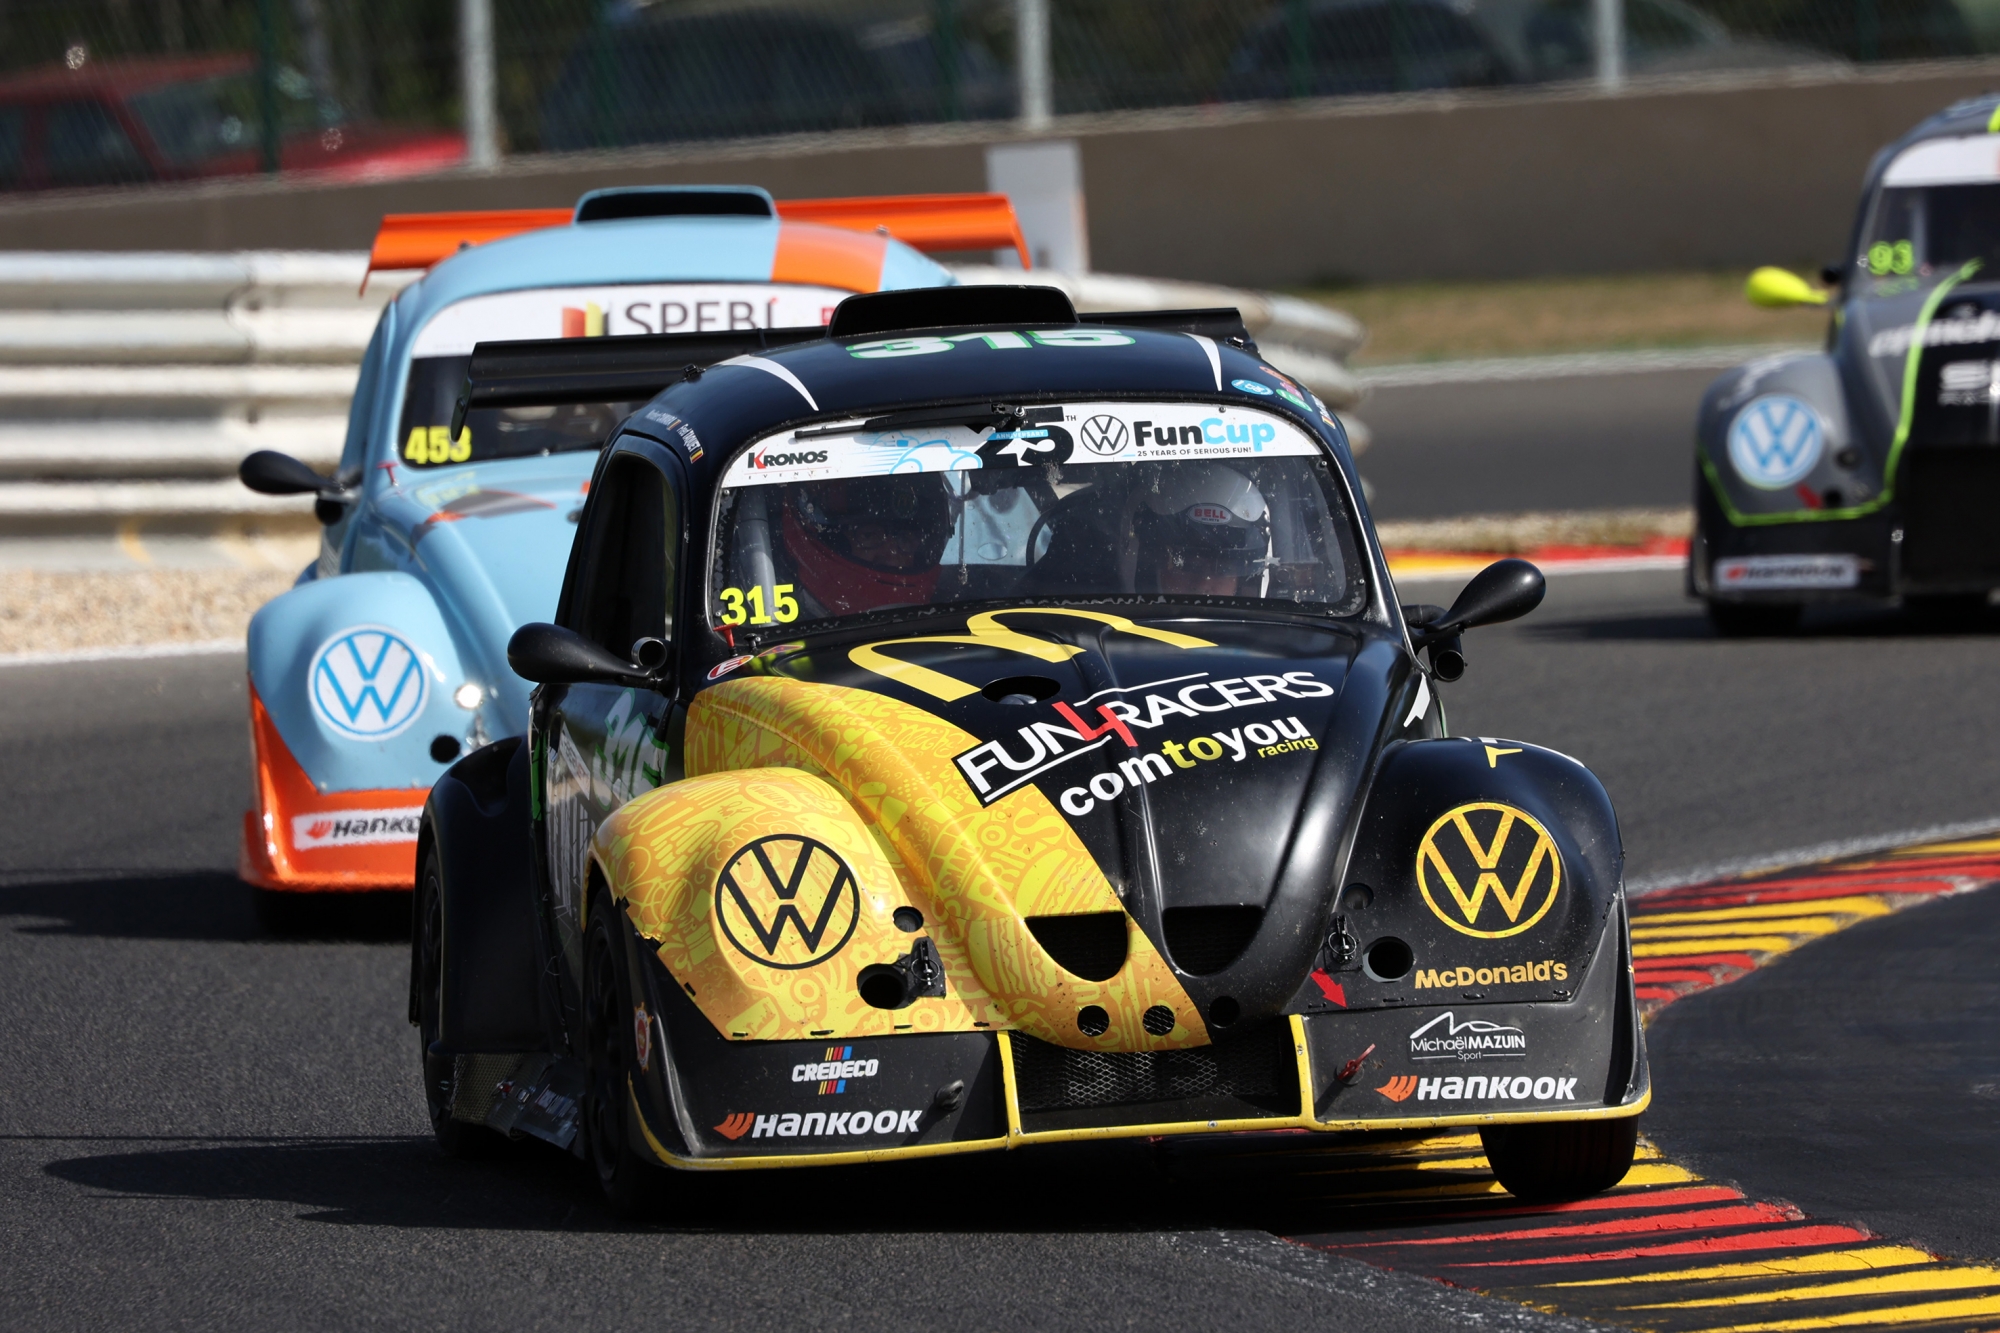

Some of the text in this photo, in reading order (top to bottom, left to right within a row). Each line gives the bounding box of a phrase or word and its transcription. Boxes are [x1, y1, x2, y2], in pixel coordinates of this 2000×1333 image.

[846, 329, 1137, 359] 315
[404, 425, 472, 464] 453
[1150, 449, 1178, 457] YEARS
[1180, 448, 1192, 456] OF
[1193, 447, 1231, 456] SERIOUS
[1232, 446, 1252, 454] FUN!
[747, 446, 828, 469] KRONOS
[1194, 508, 1227, 520] BELL
[719, 583, 799, 626] 315
[1257, 735, 1320, 759] racing
[1059, 716, 1310, 817] comtoyou
[1414, 959, 1569, 989] McDonald's
[1457, 1050, 1483, 1063] Sport
[791, 1058, 880, 1083] CREDECO
